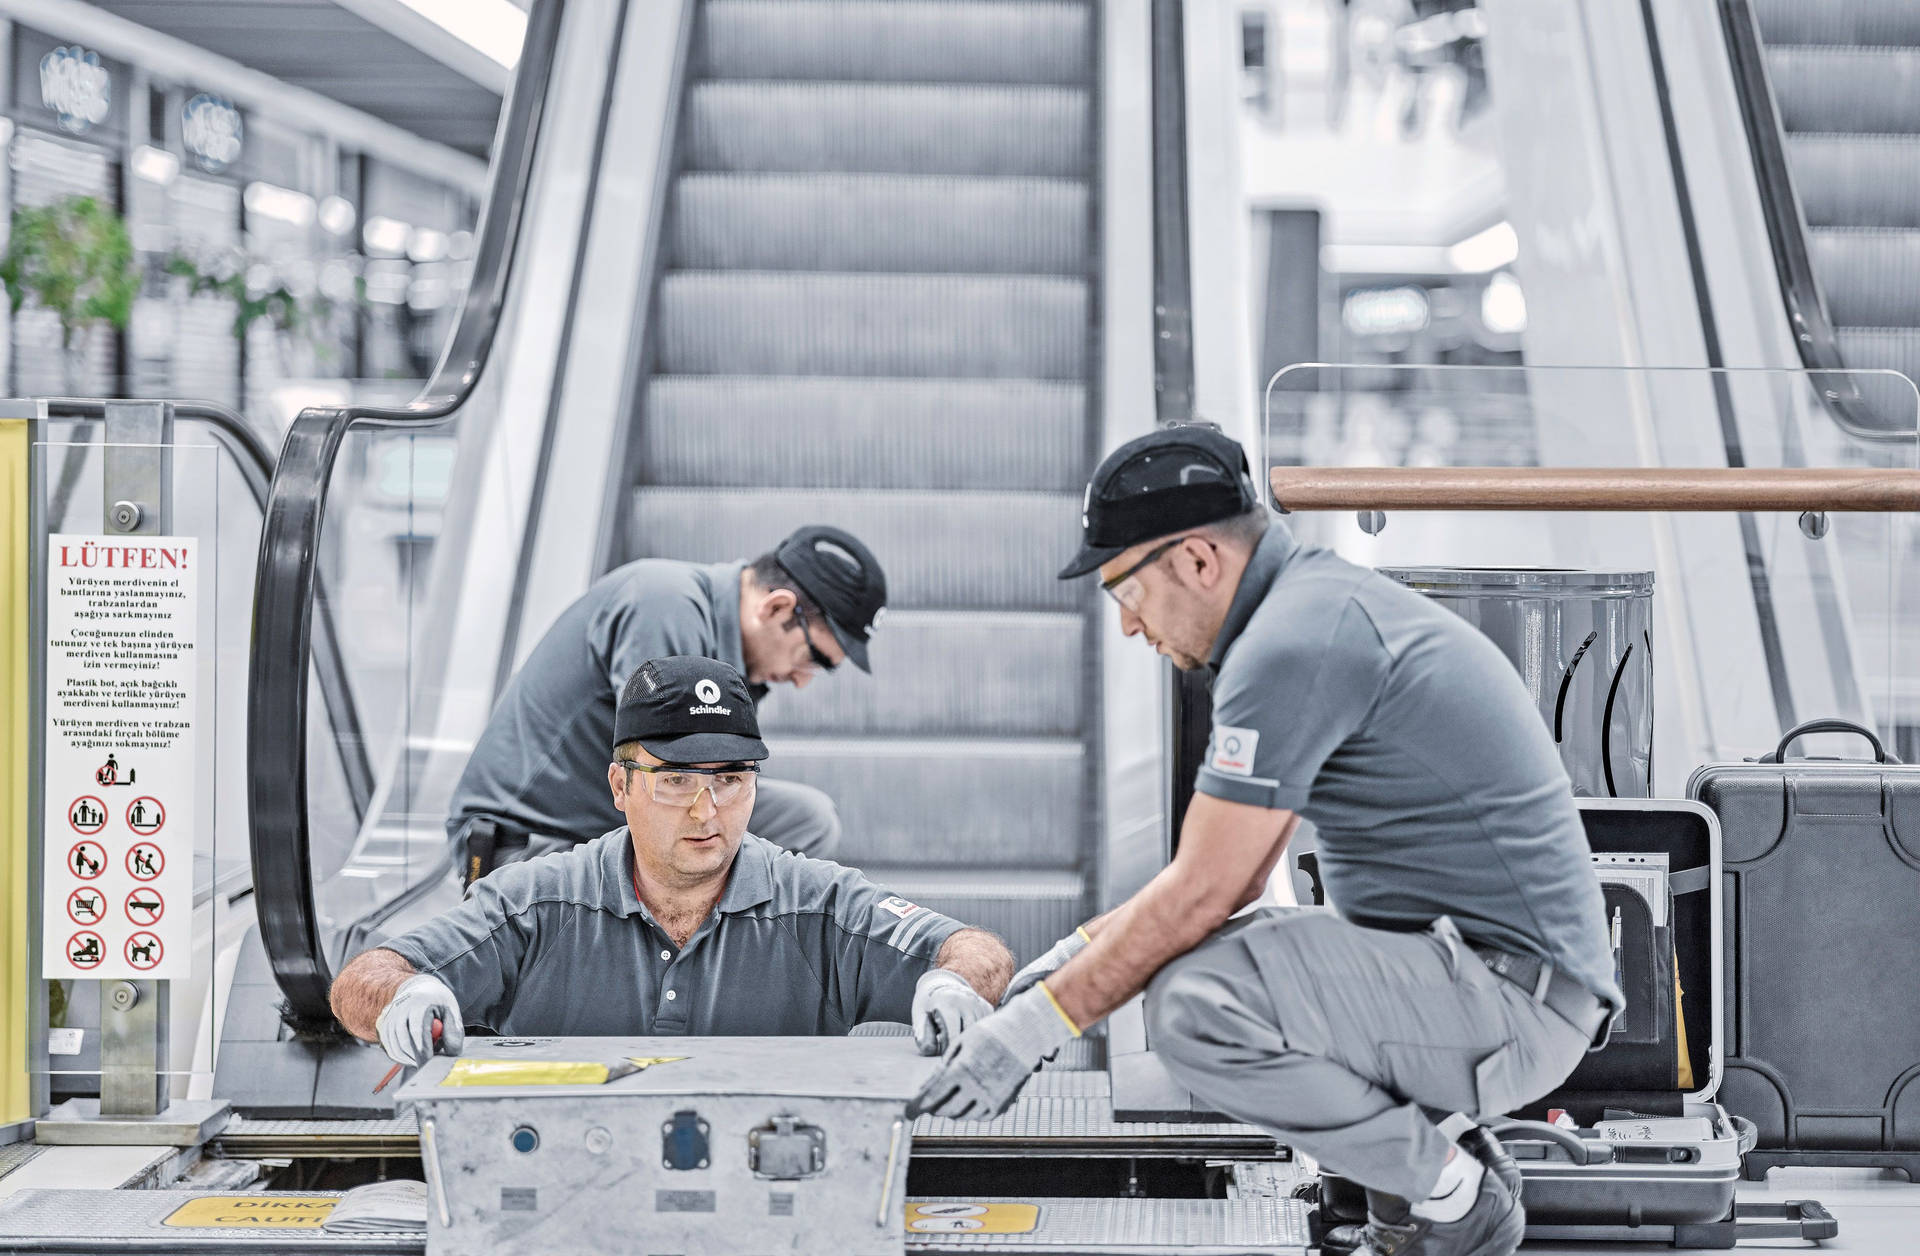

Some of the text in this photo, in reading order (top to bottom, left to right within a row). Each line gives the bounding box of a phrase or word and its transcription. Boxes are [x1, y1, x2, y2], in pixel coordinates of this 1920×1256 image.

[60, 542, 188, 569] LÜTFEN!
[68, 576, 178, 588] Yürüyen merdivenin el
[60, 588, 186, 600] bantlarına yaslanmayınız,
[88, 600, 158, 608] trabzanlardan
[112, 610, 172, 620] sarkmayınız
[138, 630, 174, 638] elinden
[50, 640, 88, 648] tutunuz
[104, 640, 118, 648] tek
[154, 642, 194, 652] yürüyen
[66, 650, 178, 660] merdiven kullanmasına
[84, 660, 160, 672] izin vermeyiniz!
[66, 678, 98, 686] Plastik
[100, 680, 118, 688] bot,
[120, 680, 138, 688] açık
[56, 688, 98, 698] ayakkabı
[114, 690, 146, 698] terlikle
[148, 690, 186, 700] yürüyen
[64, 700, 180, 710] merdiveni kullanmayınız!
[689, 704, 731, 716] Schindler
[52, 718, 92, 728] Yürüyen
[96, 720, 138, 728] merdiven
[154, 720, 190, 728] trabzan
[62, 730, 112, 738] arasındaki
[146, 730, 180, 738] bölüme
[116, 740, 170, 750] sokmayınız!
